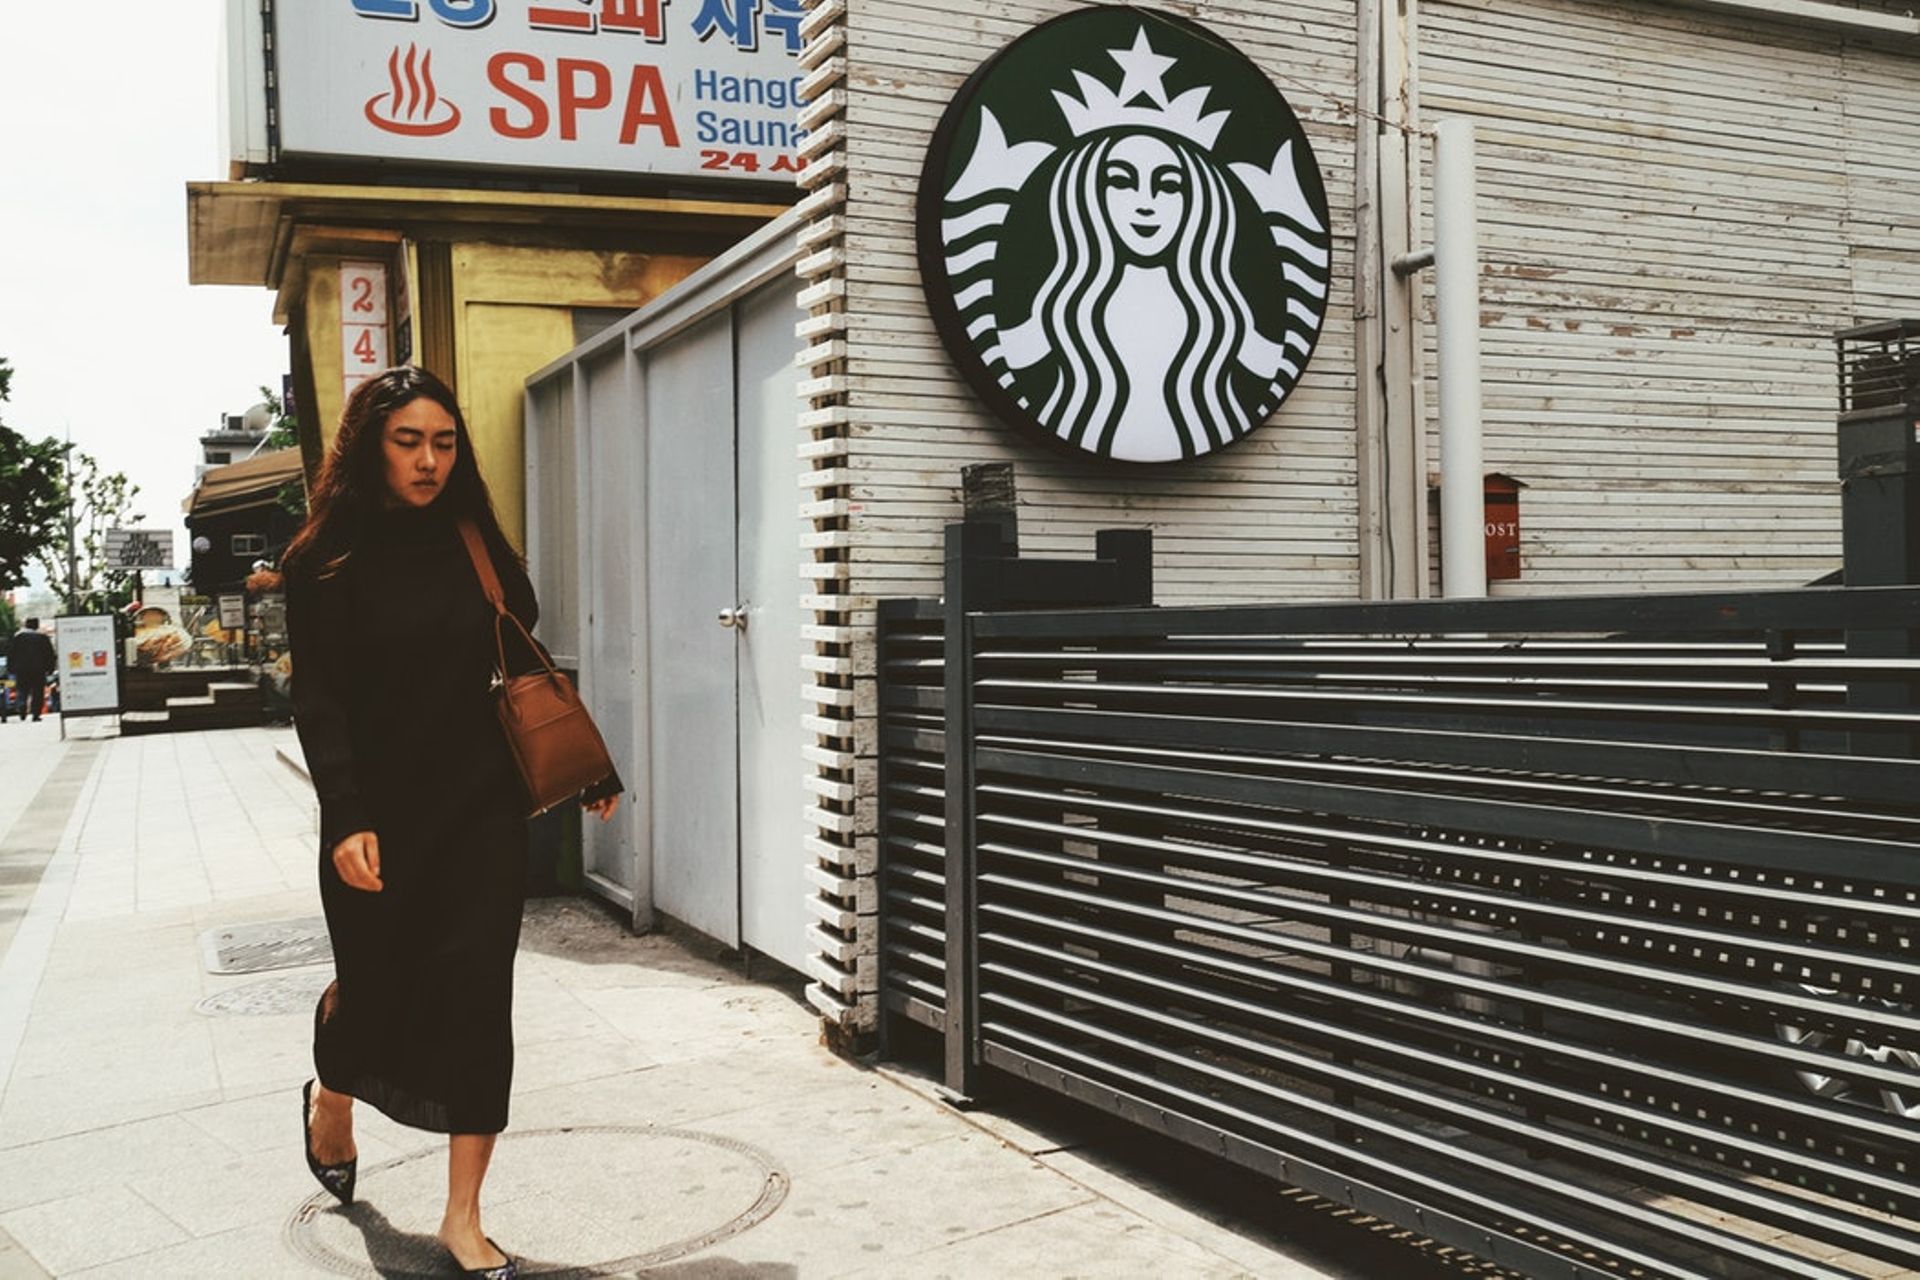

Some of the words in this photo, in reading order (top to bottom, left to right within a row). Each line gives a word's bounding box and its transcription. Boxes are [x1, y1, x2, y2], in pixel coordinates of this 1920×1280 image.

[487, 52, 680, 147] SPA
[696, 110, 809, 148] Sauna
[700, 150, 760, 172] 24
[1485, 522, 1517, 537] OST
